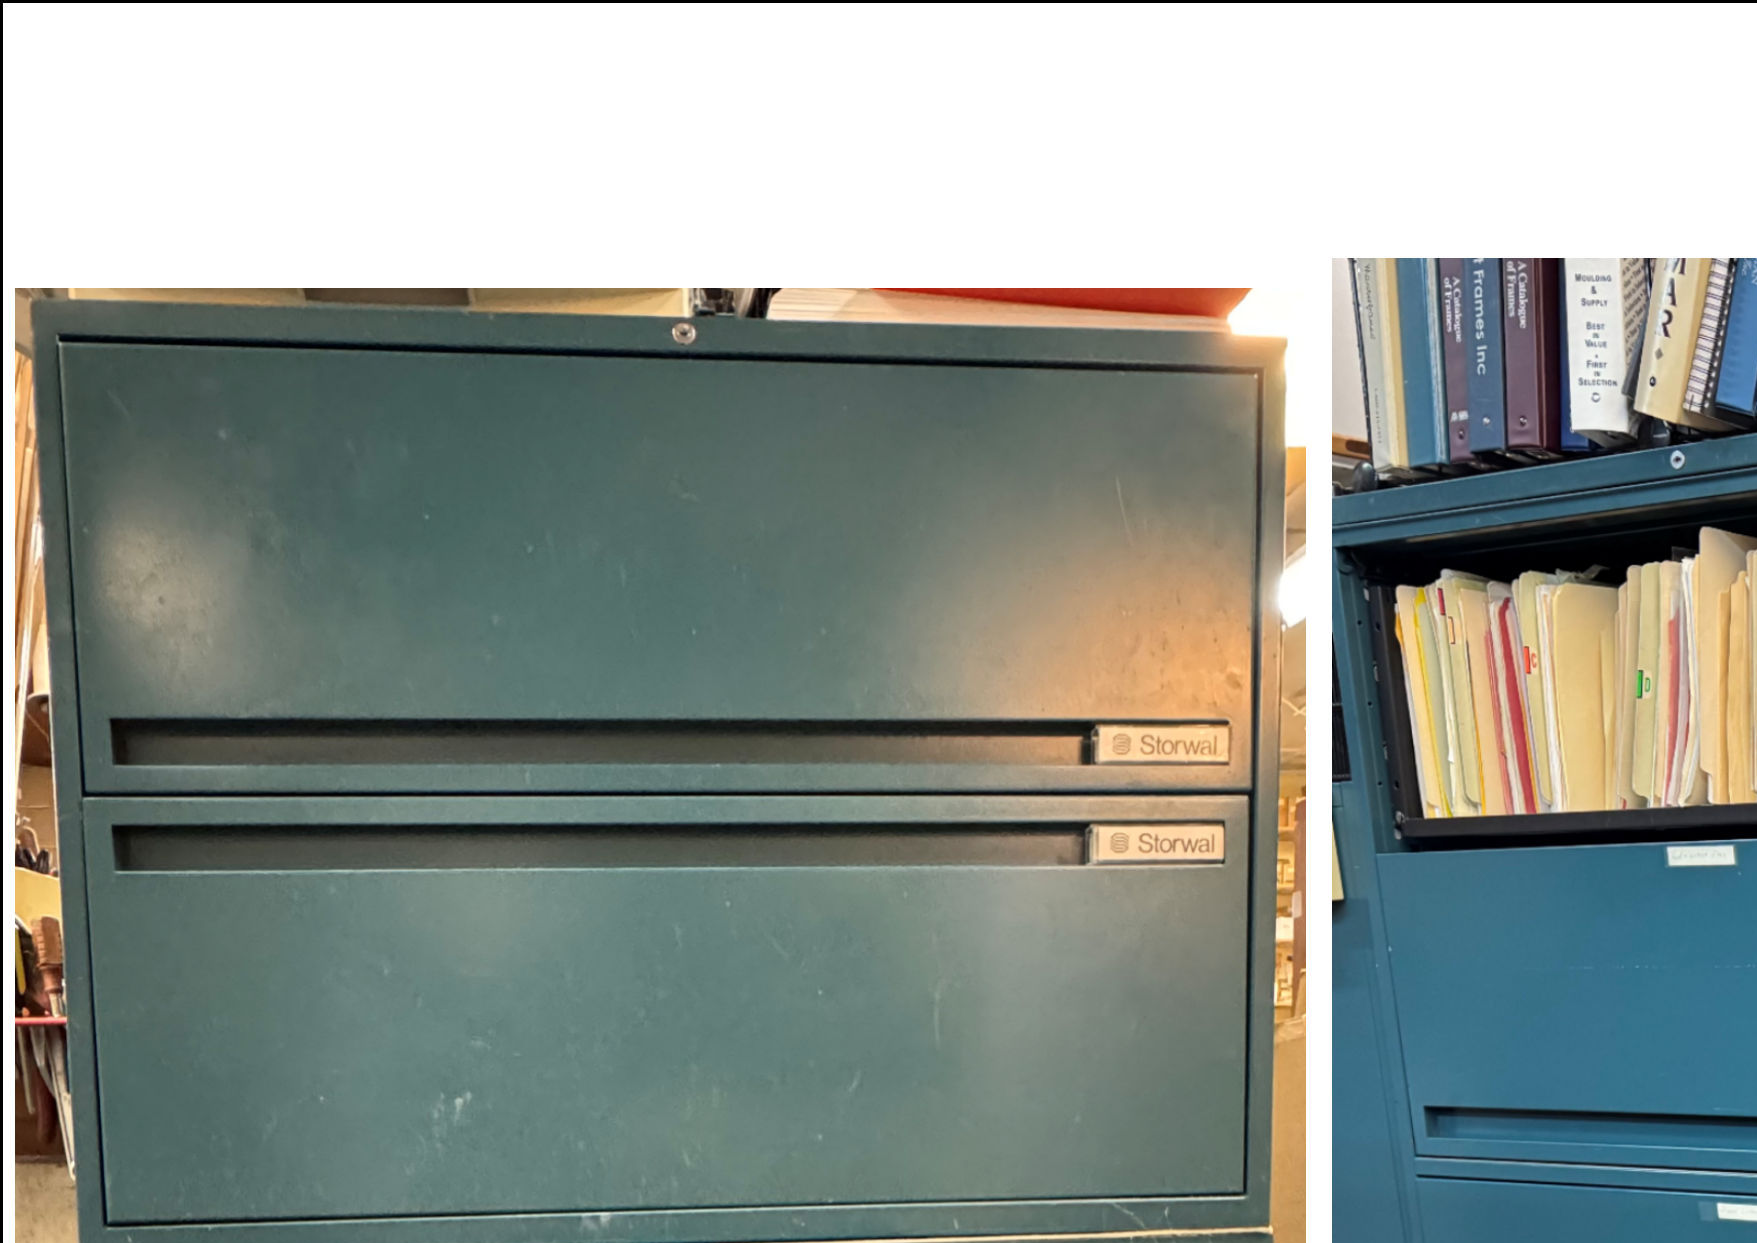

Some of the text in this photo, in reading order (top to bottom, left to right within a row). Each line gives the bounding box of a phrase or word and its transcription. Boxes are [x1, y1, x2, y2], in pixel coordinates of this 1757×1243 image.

[1574, 273, 1612, 282] MOULDING
[1506, 260, 1517, 318] of Frames
[1590, 285, 1598, 295] &
[1443, 277, 1453, 333] of Frames
[1473, 269, 1485, 340] Frames
[1518, 273, 1528, 329] Catalogue
[1580, 298, 1608, 307] SUPPLY
[1453, 288, 1463, 343] Catalogue
[1585, 321, 1605, 330] BEST
[1584, 340, 1608, 349] VALUE
[1476, 345, 1488, 376] Inc
[1585, 360, 1608, 369] FIRST
[1577, 377, 1618, 387] SELECTION
[1139, 734, 1218, 756] Storwal
[1137, 832, 1216, 854] Storwal
